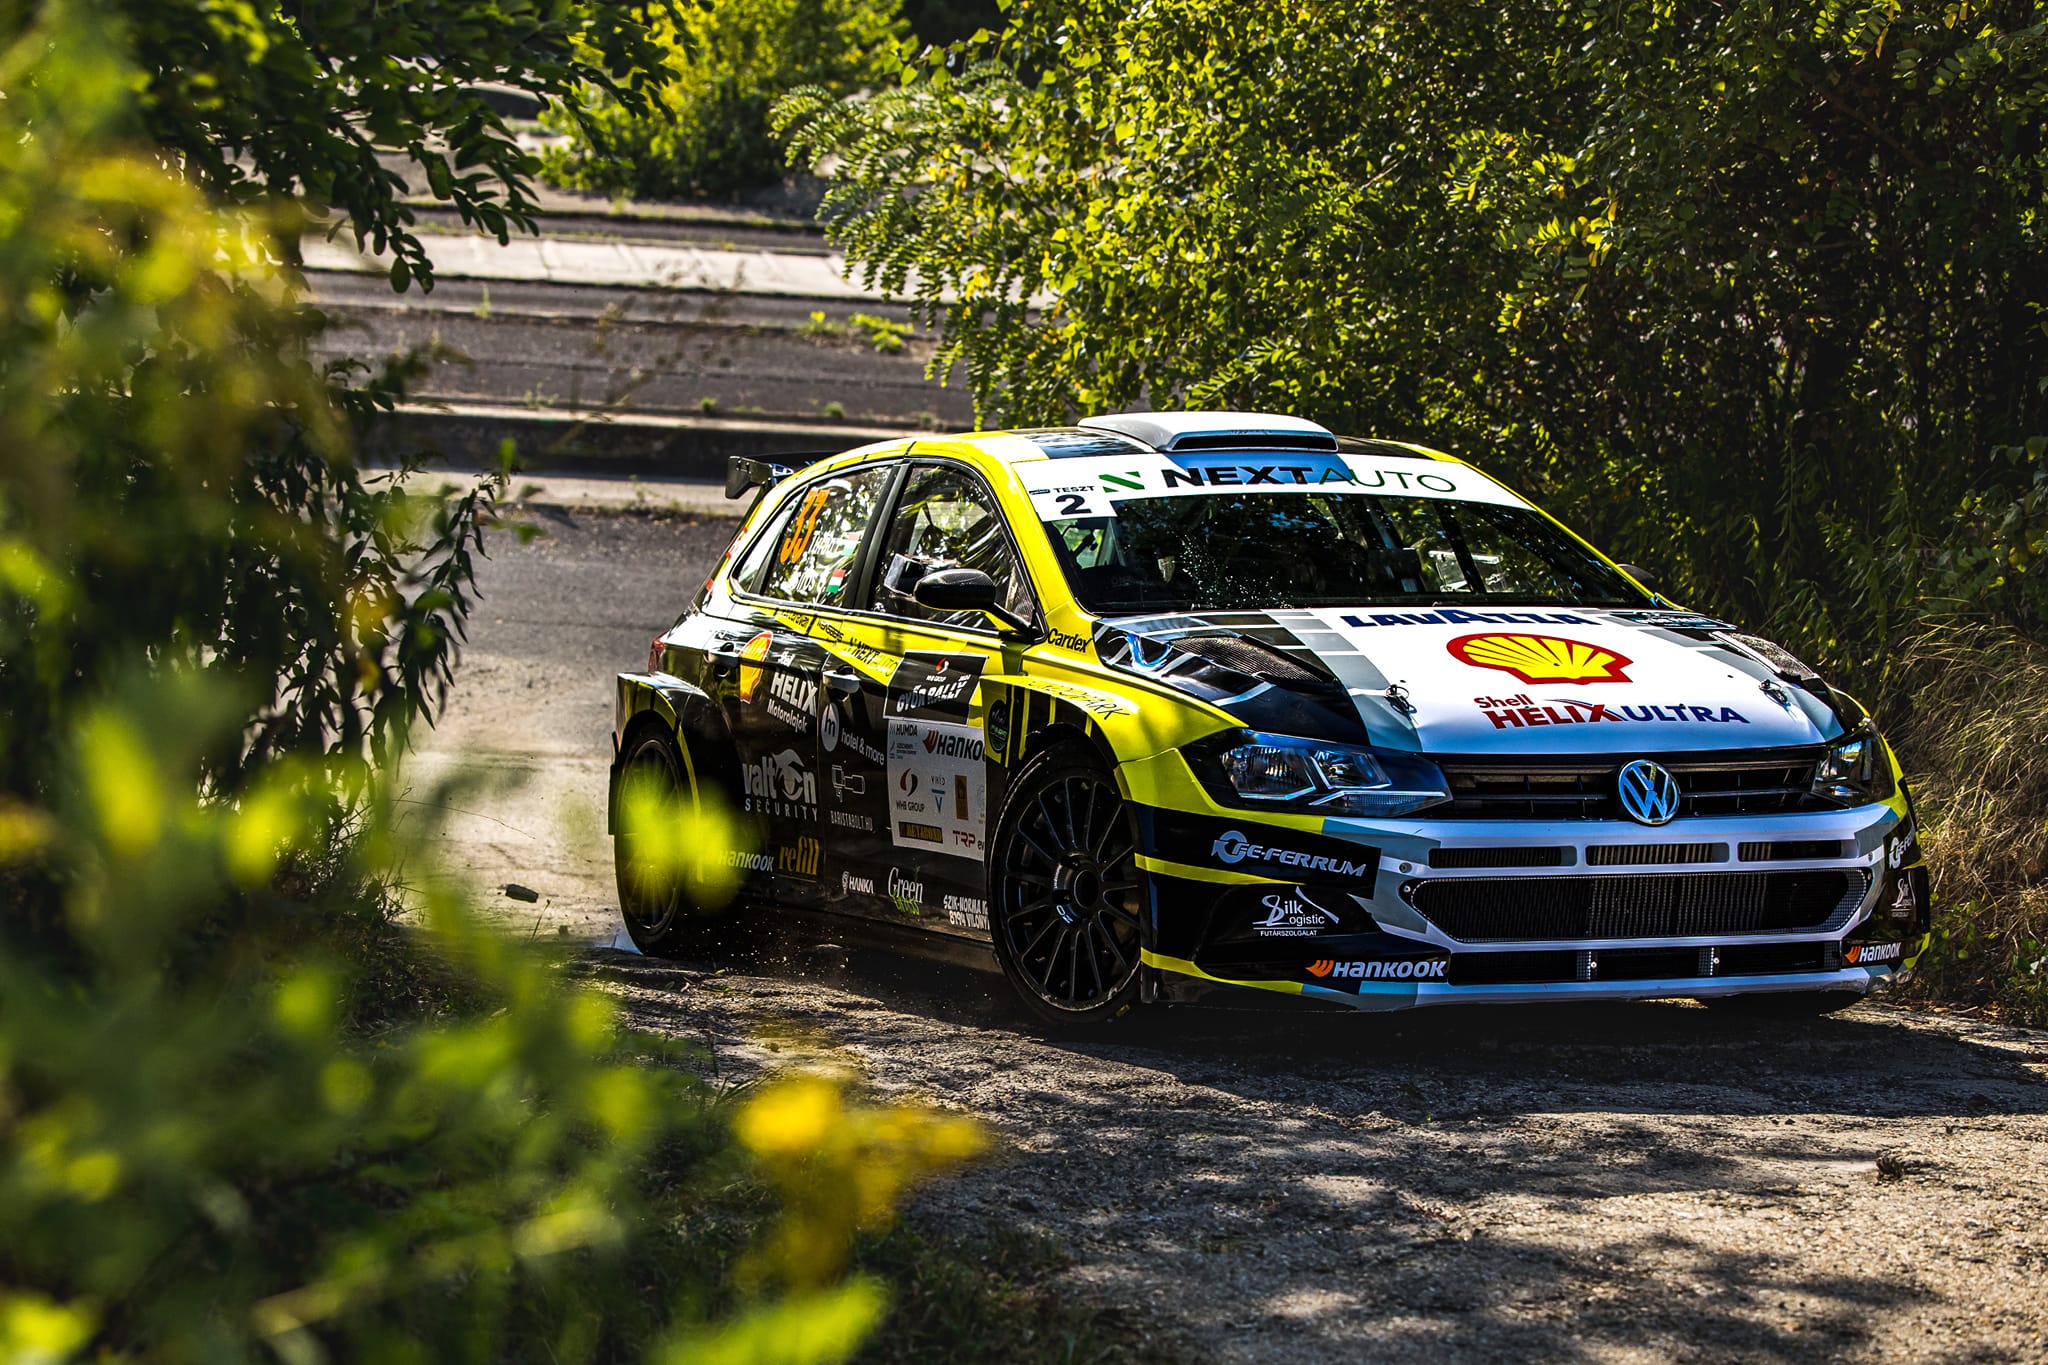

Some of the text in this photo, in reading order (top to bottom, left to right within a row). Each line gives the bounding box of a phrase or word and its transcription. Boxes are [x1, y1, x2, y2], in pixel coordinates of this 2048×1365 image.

[1053, 485, 1095, 493] TESZT
[1055, 494, 1092, 515] 2
[1048, 628, 1093, 653] Cardex
[770, 671, 818, 717] HELIX
[1473, 694, 1535, 709] Shell
[766, 698, 808, 733] Motorolajok
[896, 723, 918, 736] HUMDA
[841, 727, 859, 751] hotel
[859, 738, 865, 756] &
[865, 744, 885, 766] more
[745, 798, 818, 822] SECURITY
[952, 830, 976, 848] TRP
[779, 836, 820, 875] refill
[849, 876, 873, 894] HANKA
[888, 867, 923, 904] Green
